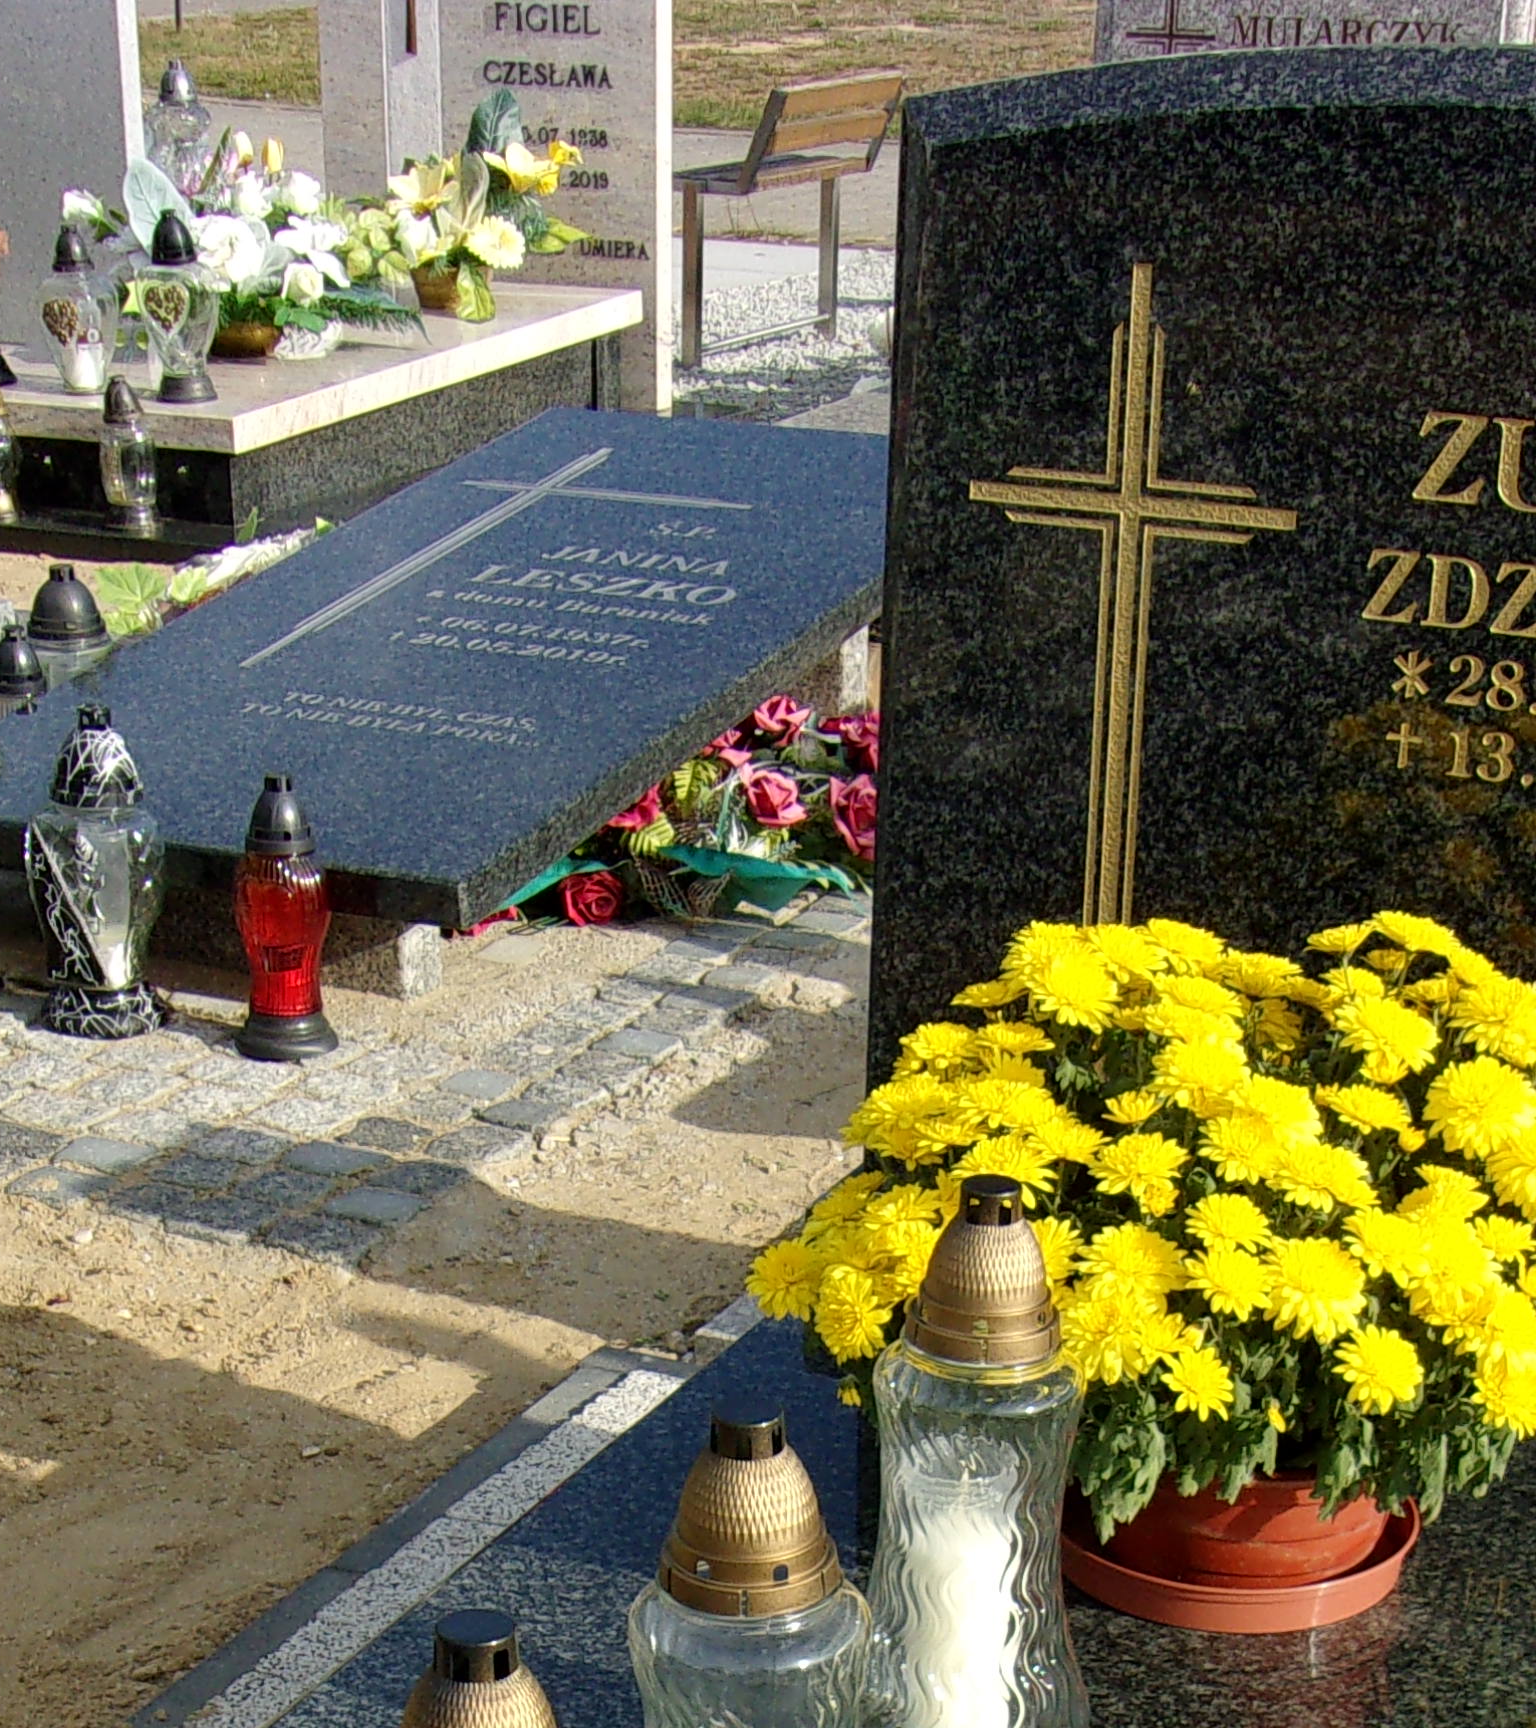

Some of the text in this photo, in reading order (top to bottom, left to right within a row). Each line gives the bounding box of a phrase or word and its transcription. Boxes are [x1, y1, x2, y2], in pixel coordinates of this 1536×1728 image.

[495, 2, 601, 35] FIGIEL
[482, 61, 614, 90] CZESŁAWA
[541, 545, 731, 577] JANINA
[469, 563, 739, 607] LESZKO
